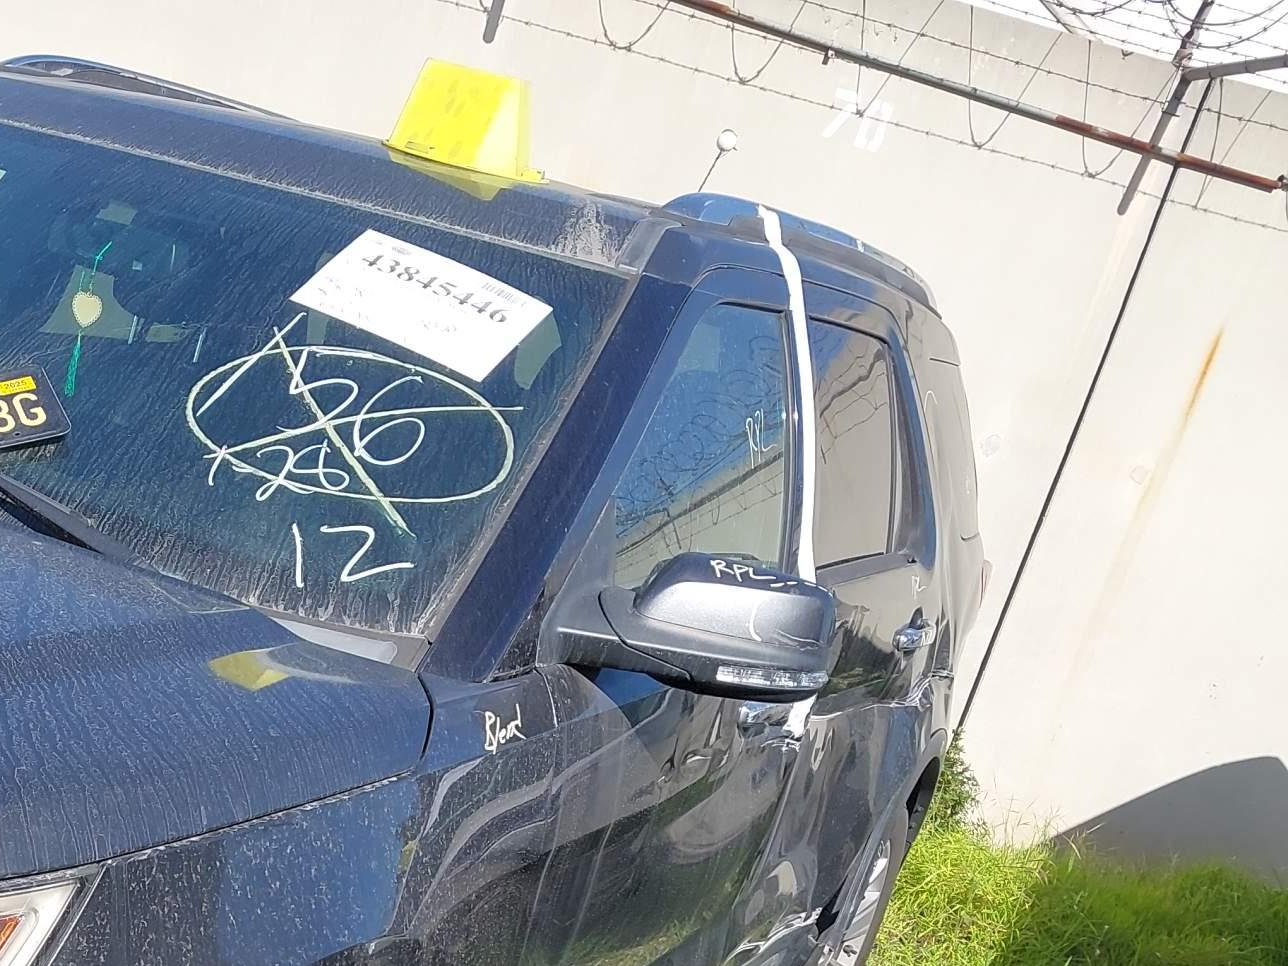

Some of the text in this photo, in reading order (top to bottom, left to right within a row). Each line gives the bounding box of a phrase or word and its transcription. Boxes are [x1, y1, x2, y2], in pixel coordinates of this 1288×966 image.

[362, 254, 511, 322] 43845446
[291, 522, 415, 589] 12
[710, 559, 777, 583] RPL
